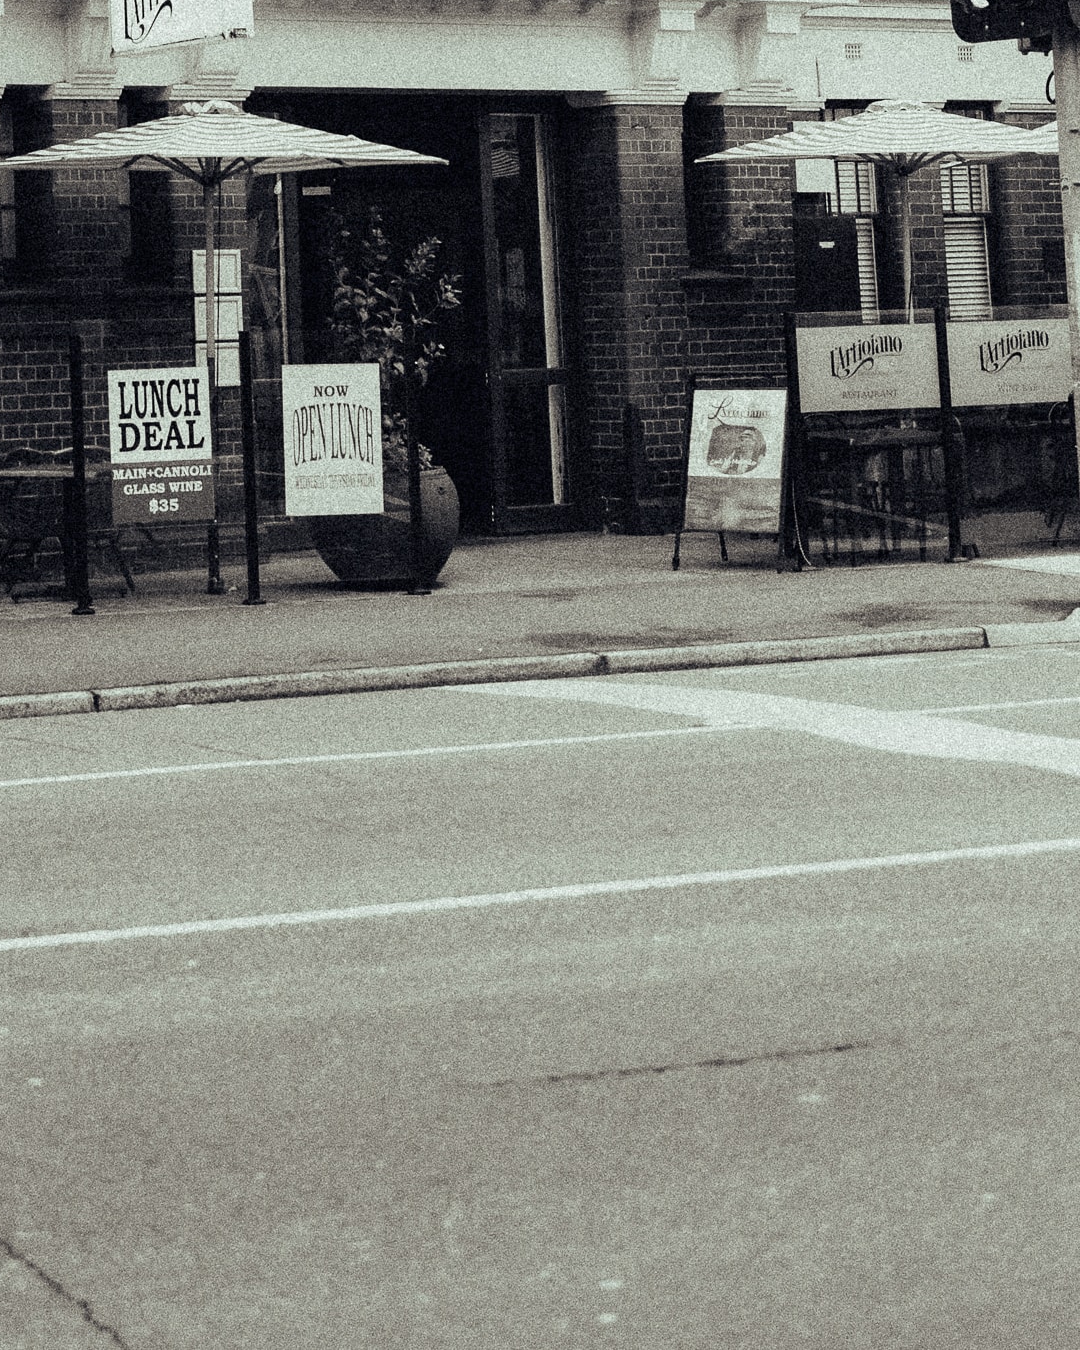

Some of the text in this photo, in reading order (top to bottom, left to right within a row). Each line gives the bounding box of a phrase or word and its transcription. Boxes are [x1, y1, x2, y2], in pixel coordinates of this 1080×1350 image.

[118, 378, 201, 419] LUNCH
[313, 385, 349, 397] NOW
[118, 420, 205, 452] DEAL
[293, 402, 374, 466] OPEN LUNCH
[112, 465, 212, 480] MAIN+CANNOLI
[123, 480, 203, 495] GLASS WINE
[149, 497, 179, 514] $35
